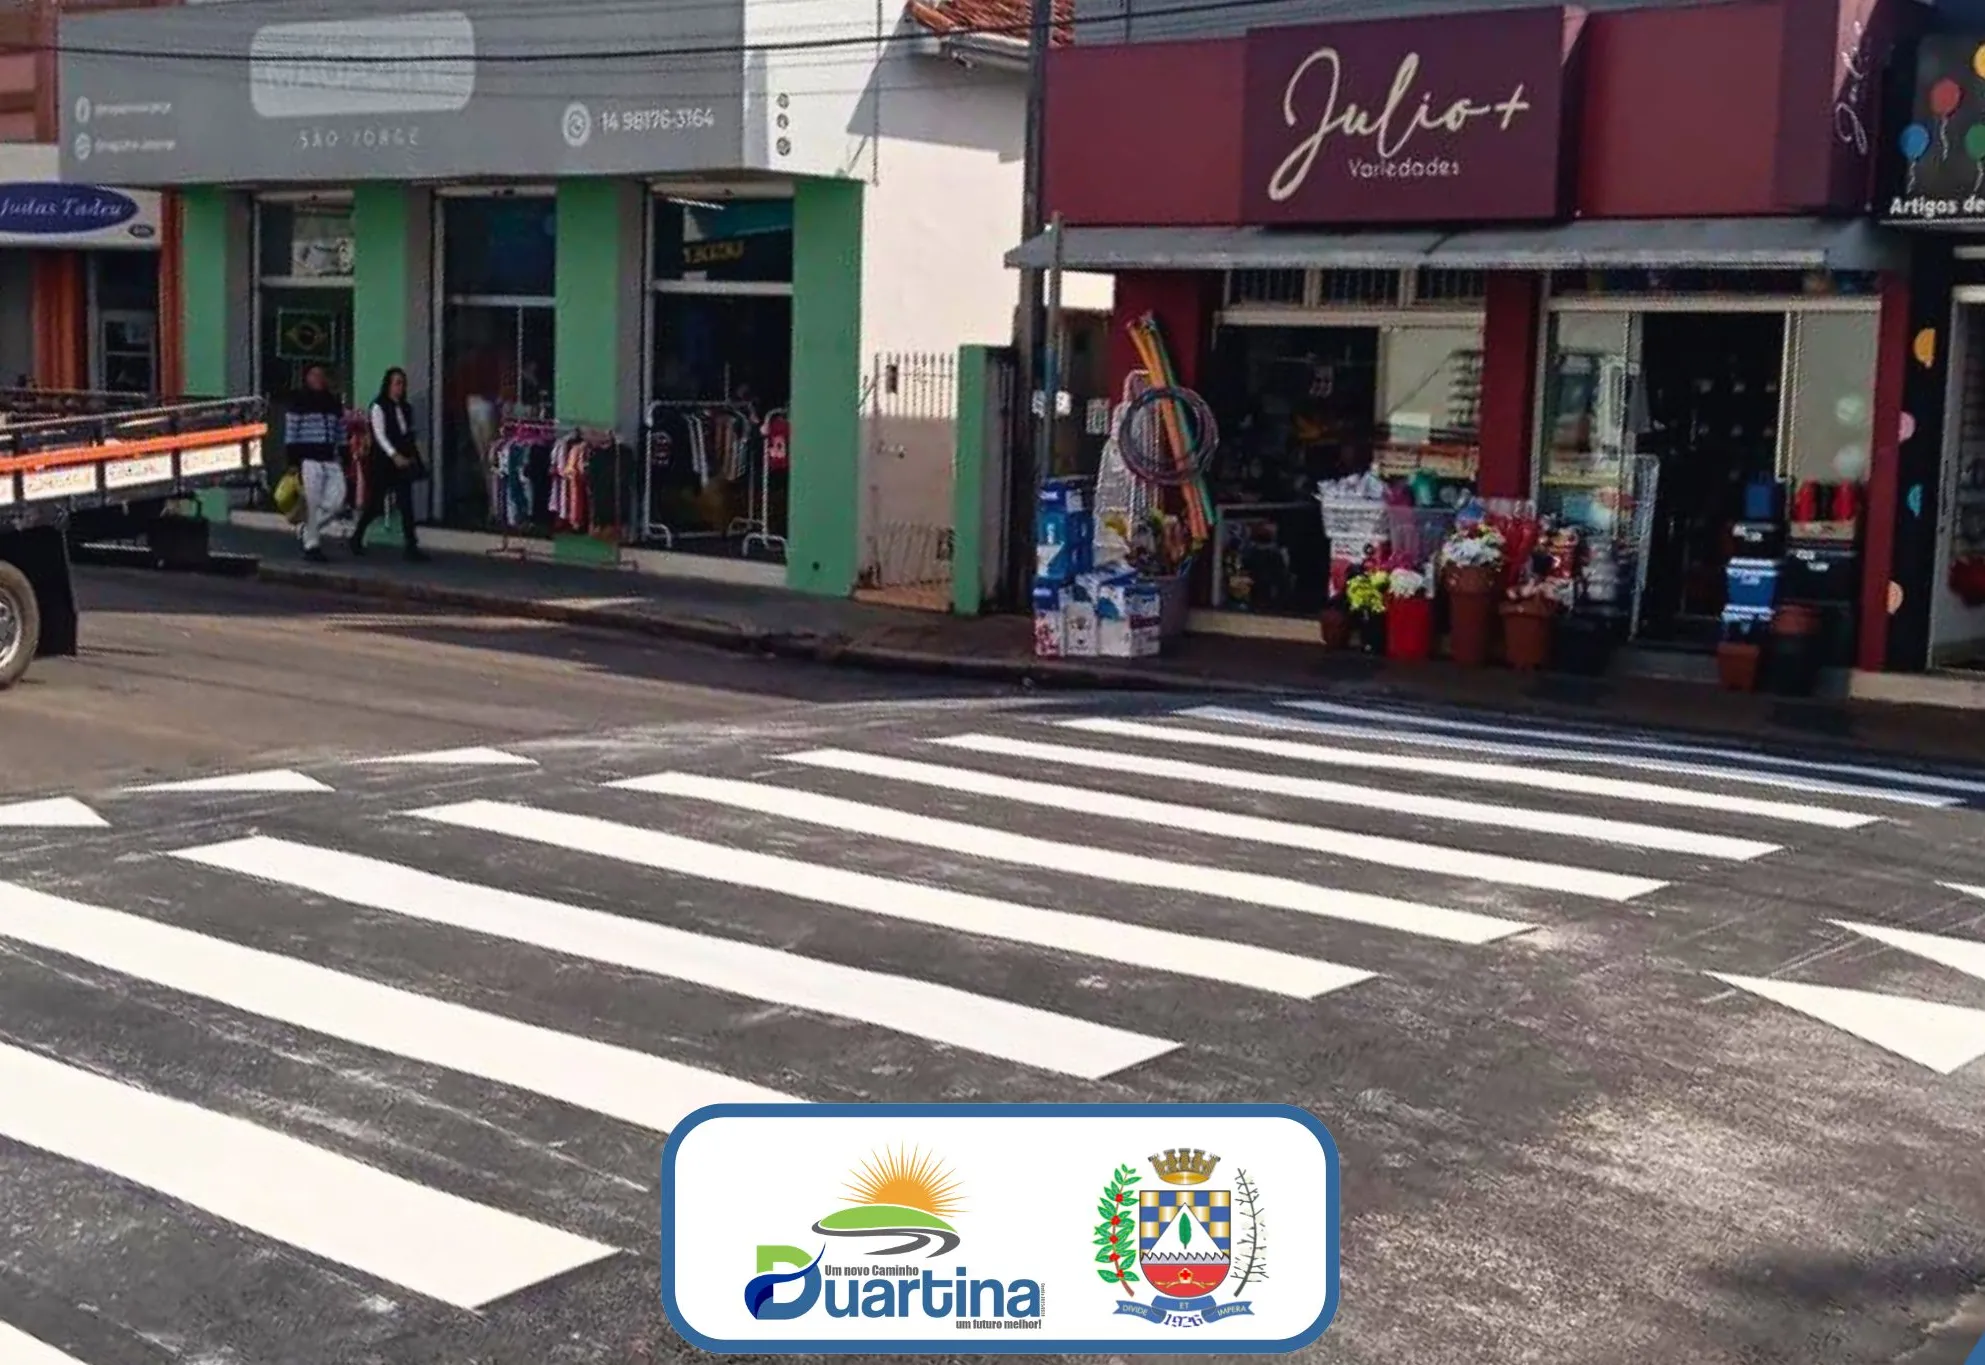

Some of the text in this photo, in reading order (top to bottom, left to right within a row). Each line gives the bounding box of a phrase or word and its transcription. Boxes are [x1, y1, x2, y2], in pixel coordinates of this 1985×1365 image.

[602, 111, 620, 134] 14
[1350, 157, 1460, 179] Variedades
[1889, 194, 1985, 219] Artigos de
